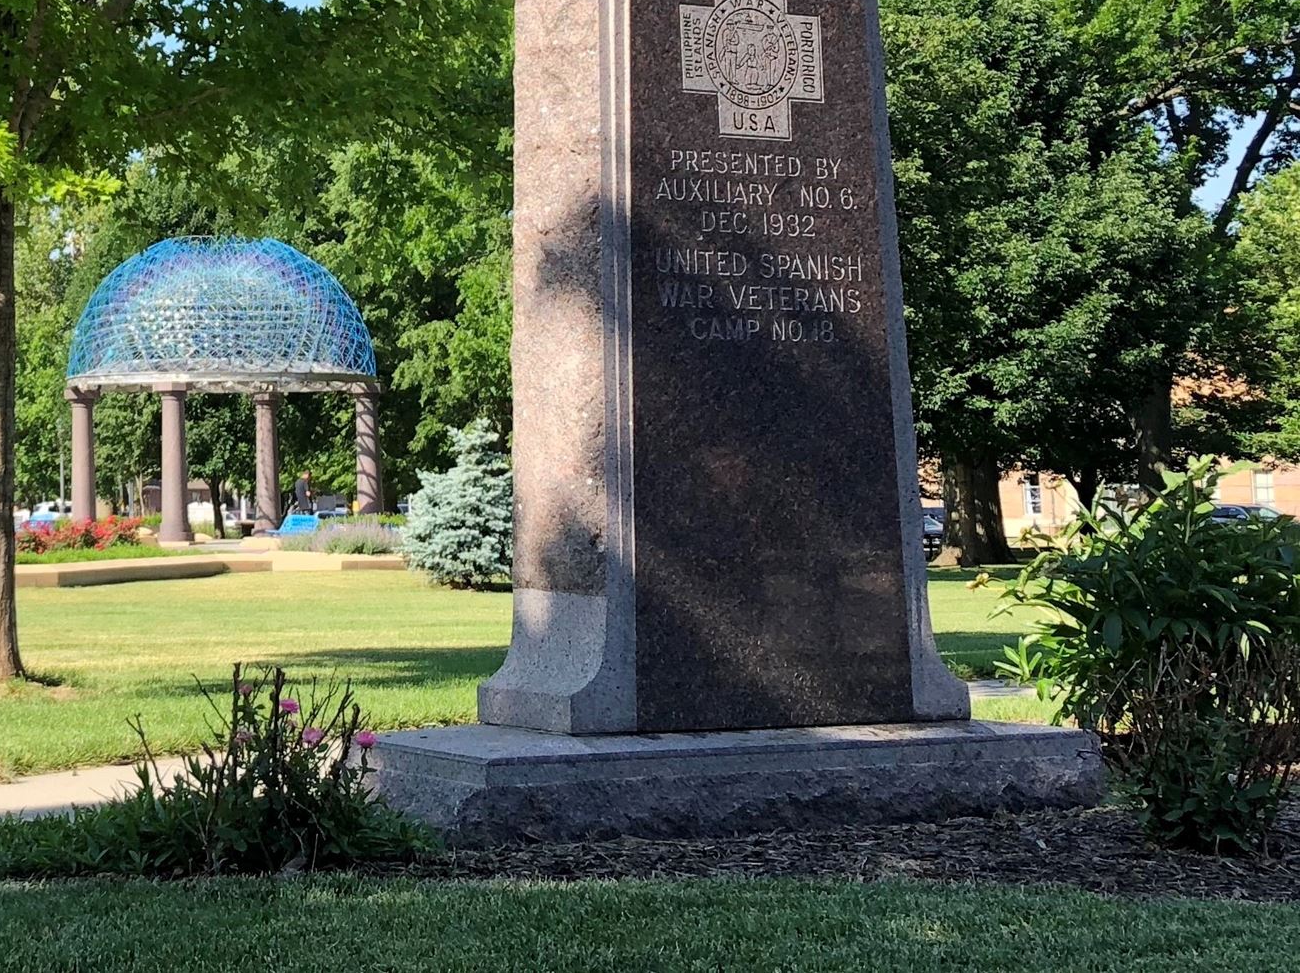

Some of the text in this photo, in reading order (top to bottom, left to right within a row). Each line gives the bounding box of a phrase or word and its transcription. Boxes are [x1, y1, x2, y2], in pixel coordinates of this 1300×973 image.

[682, 13, 694, 79] PHILIPPINE
[692, 18, 703, 78] ISLANDS
[706, 13, 722, 80] SPANISH
[777, 14, 797, 85] VETERANS
[726, 87, 781, 107] 1898-1902
[733, 112, 780, 133] U.S.A.
[670, 149, 842, 180] PRESENTED BY
[655, 177, 778, 206] AUXILIARY
[800, 185, 833, 209] NO.
[763, 212, 816, 237] 1932
[655, 247, 862, 282] UNITED SPANISH
[656, 280, 861, 313] WAR VETERANS
[690, 316, 760, 341] CAMP
[772, 318, 807, 342] NO.
